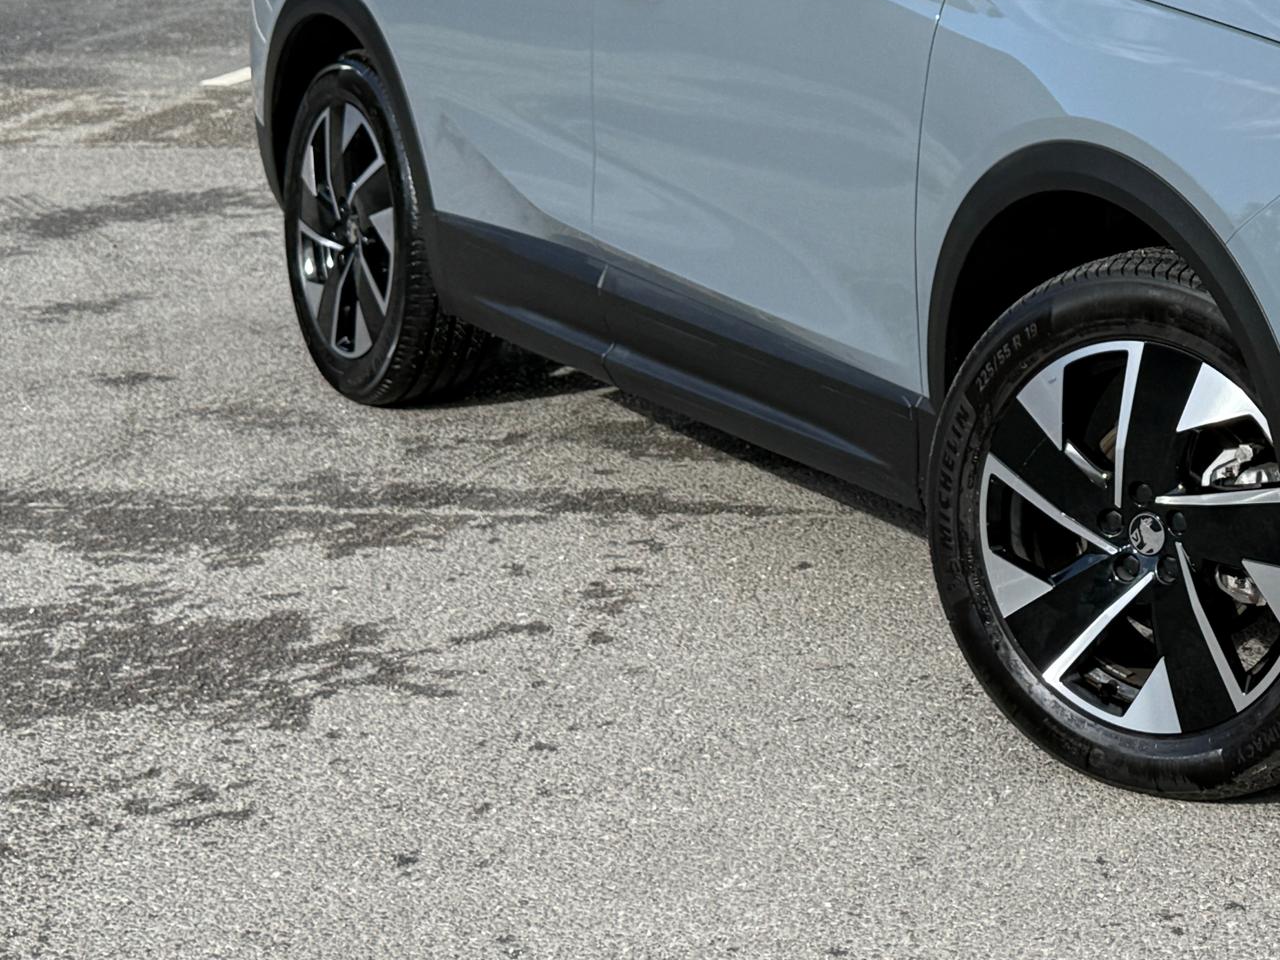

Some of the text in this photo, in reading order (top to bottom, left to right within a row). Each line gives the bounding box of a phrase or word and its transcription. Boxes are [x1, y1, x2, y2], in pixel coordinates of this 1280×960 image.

[975, 322, 1039, 392] 225/55 R 19
